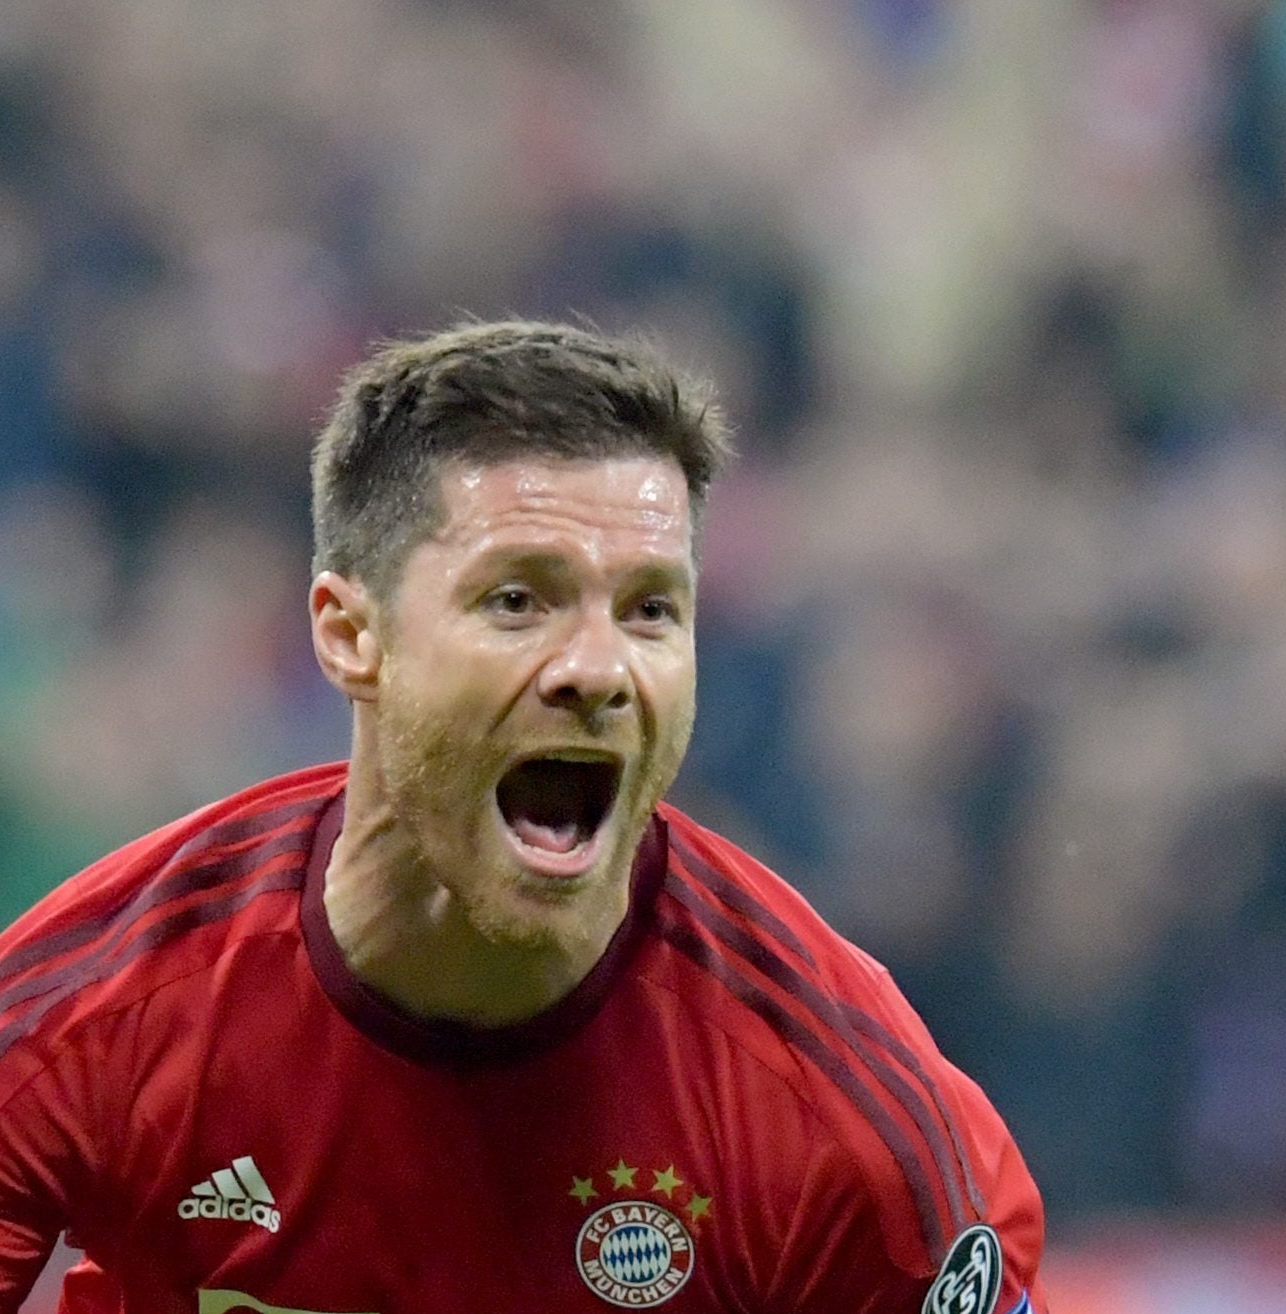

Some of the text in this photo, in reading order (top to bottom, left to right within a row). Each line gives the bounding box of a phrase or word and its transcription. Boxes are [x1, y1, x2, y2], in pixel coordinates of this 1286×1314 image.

[177, 1195, 281, 1233] adidas
[587, 1207, 688, 1252] FC BAYERN
